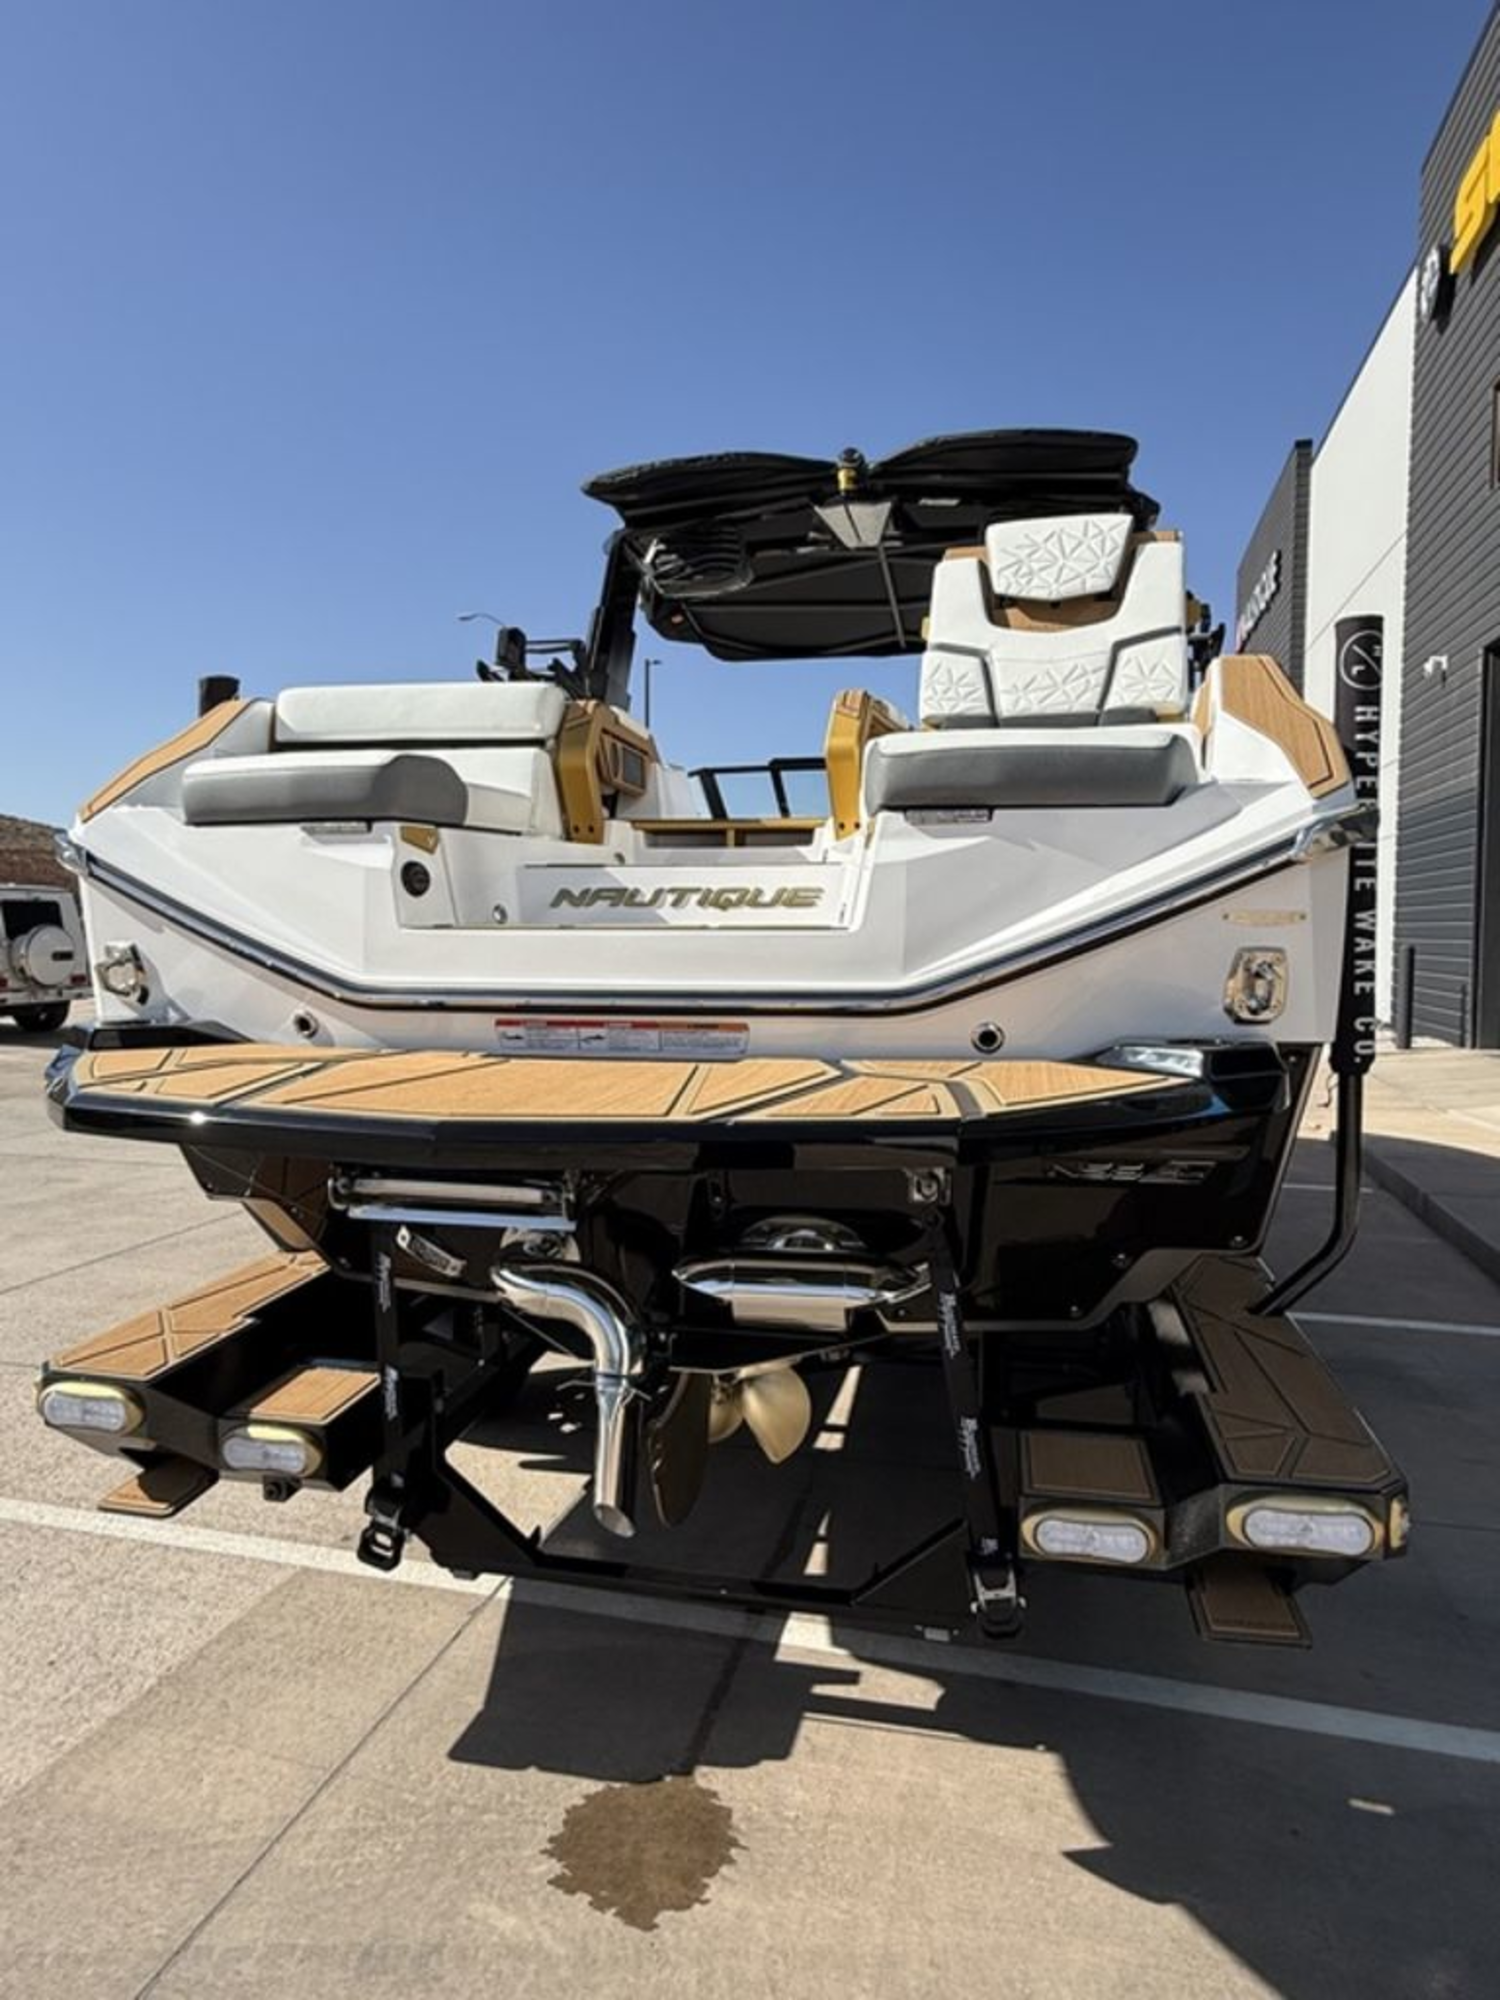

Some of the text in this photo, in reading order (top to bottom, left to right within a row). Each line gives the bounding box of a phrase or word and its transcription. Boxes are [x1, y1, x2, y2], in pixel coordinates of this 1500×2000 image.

[1354, 705, 1379, 891] HYPERITE
[549, 886, 825, 912] NAUTIQUE
[1353, 910, 1377, 996] WAKE
